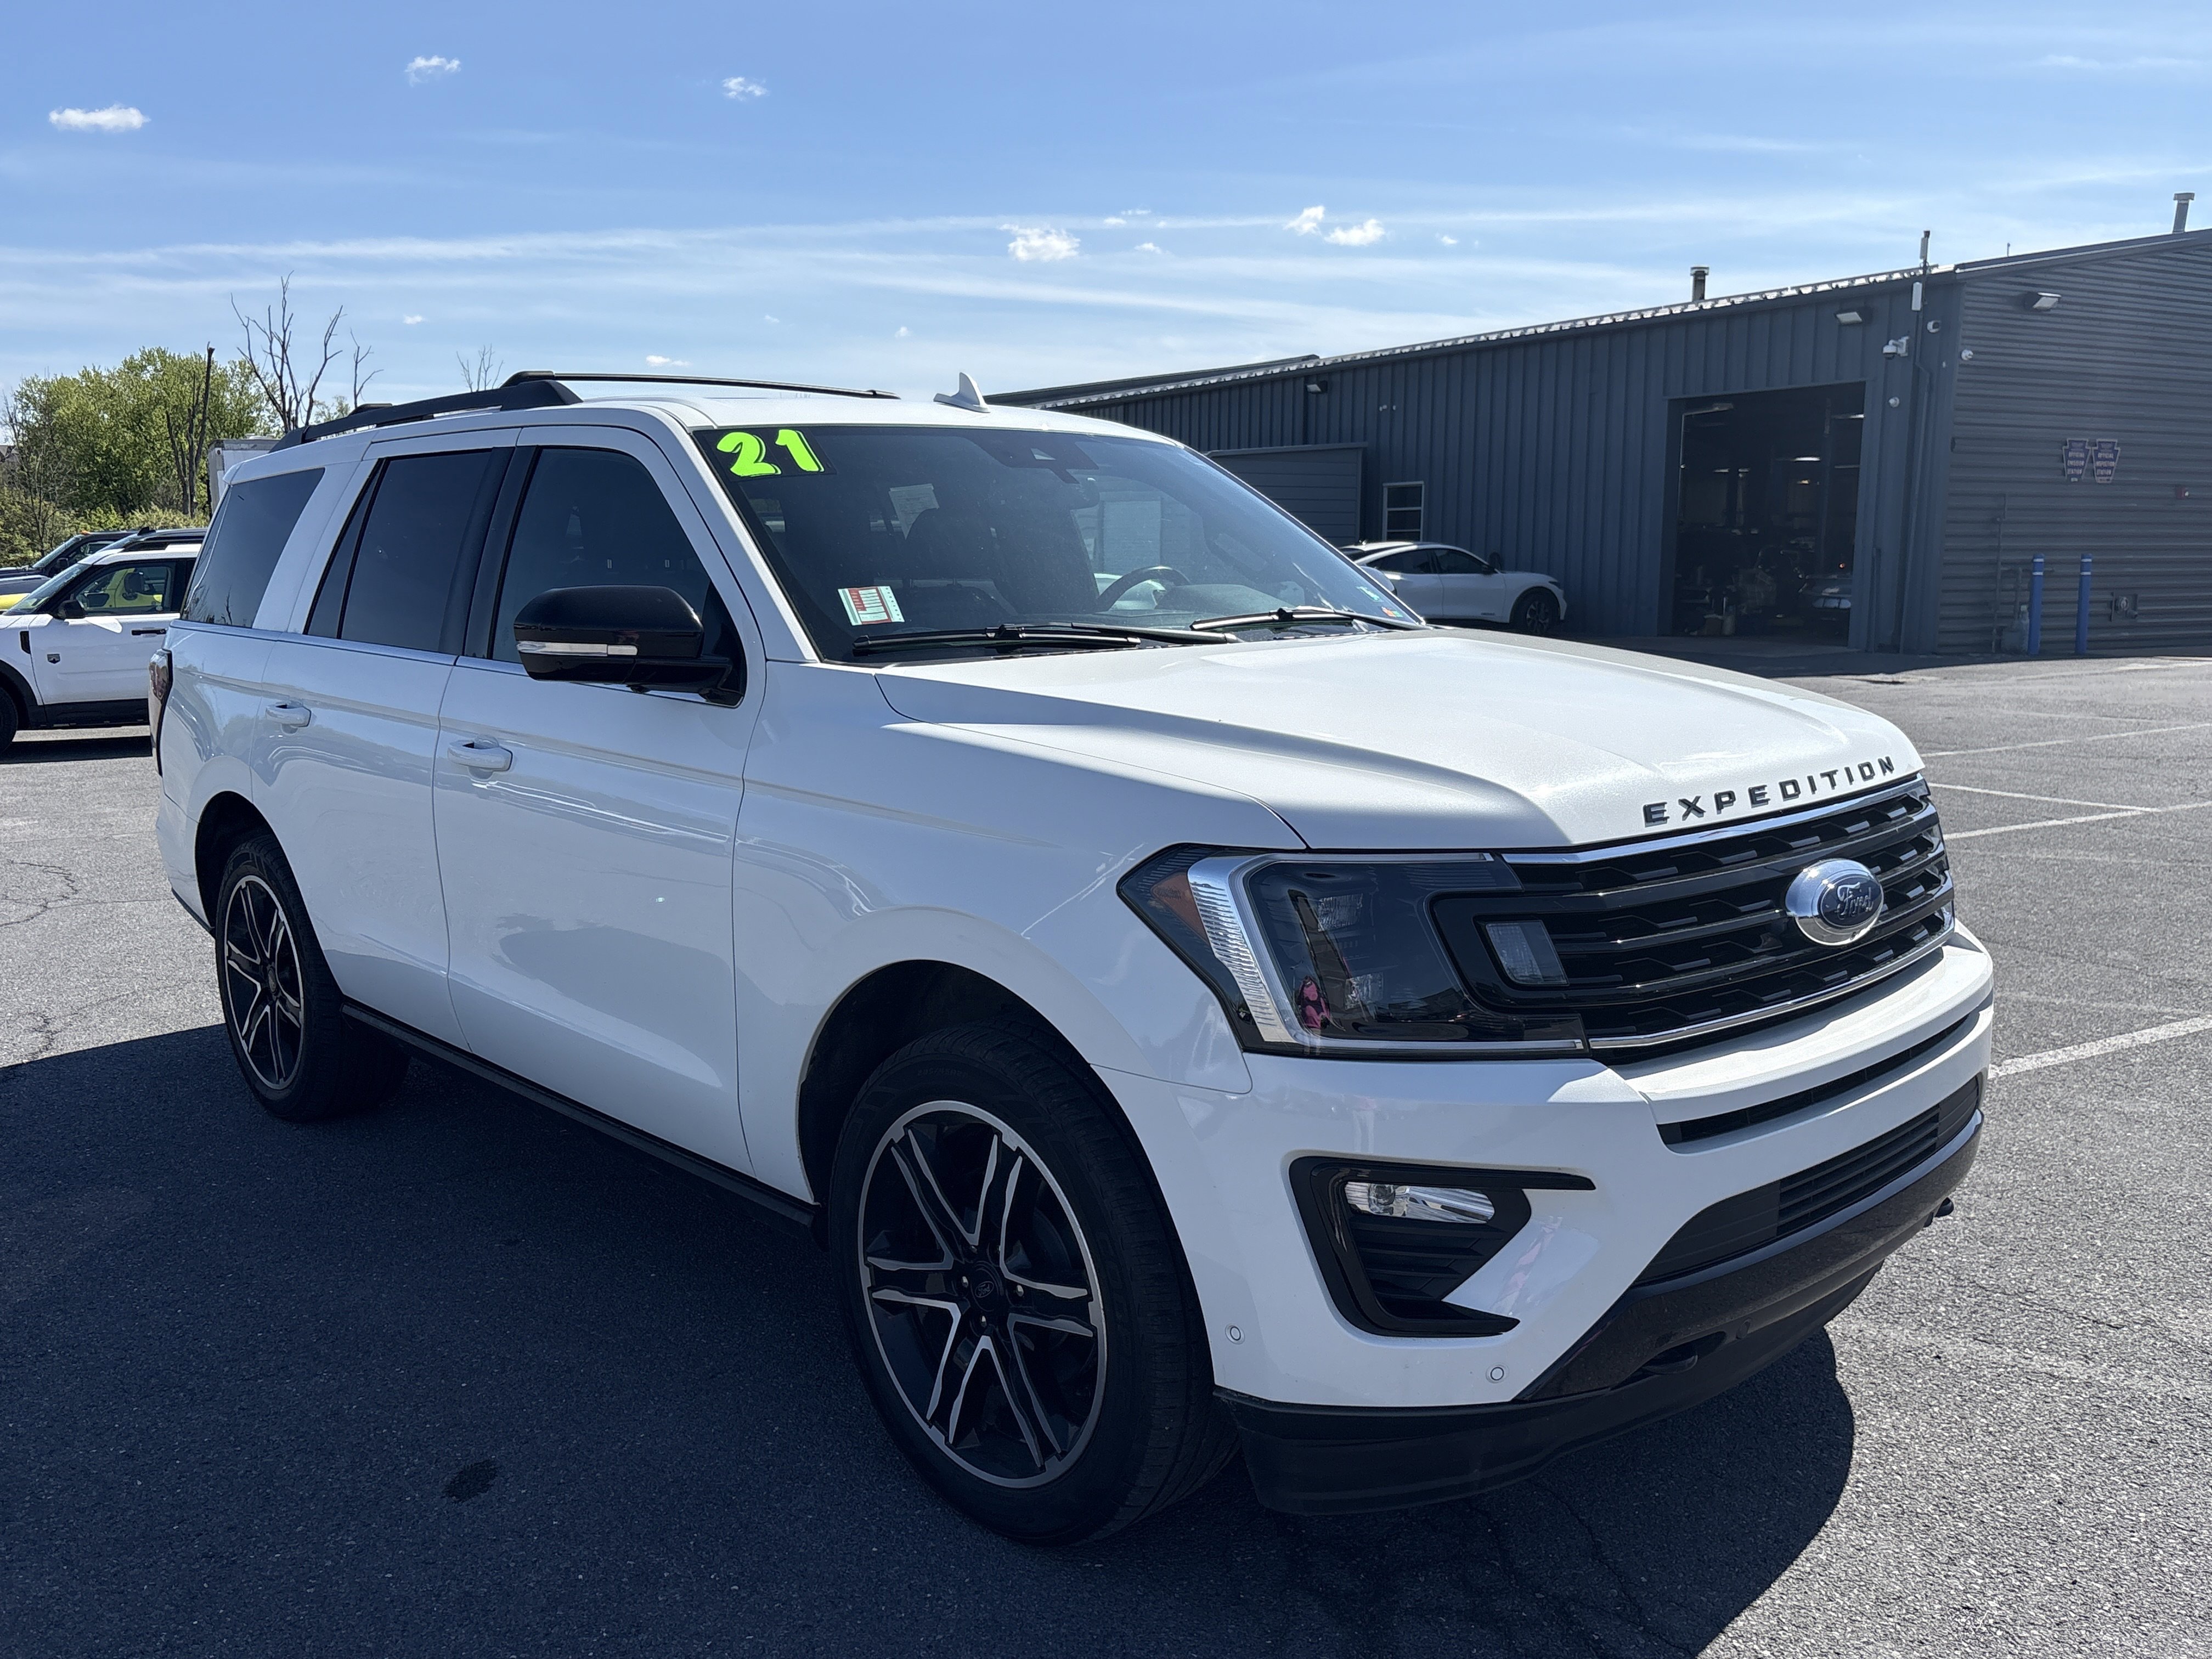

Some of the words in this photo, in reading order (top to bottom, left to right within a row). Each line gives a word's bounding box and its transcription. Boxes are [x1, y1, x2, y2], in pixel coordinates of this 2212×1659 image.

[716, 429, 825, 477] 21
[1643, 755, 1894, 827] EXPEDITION
[1835, 882, 1874, 921] Ford
